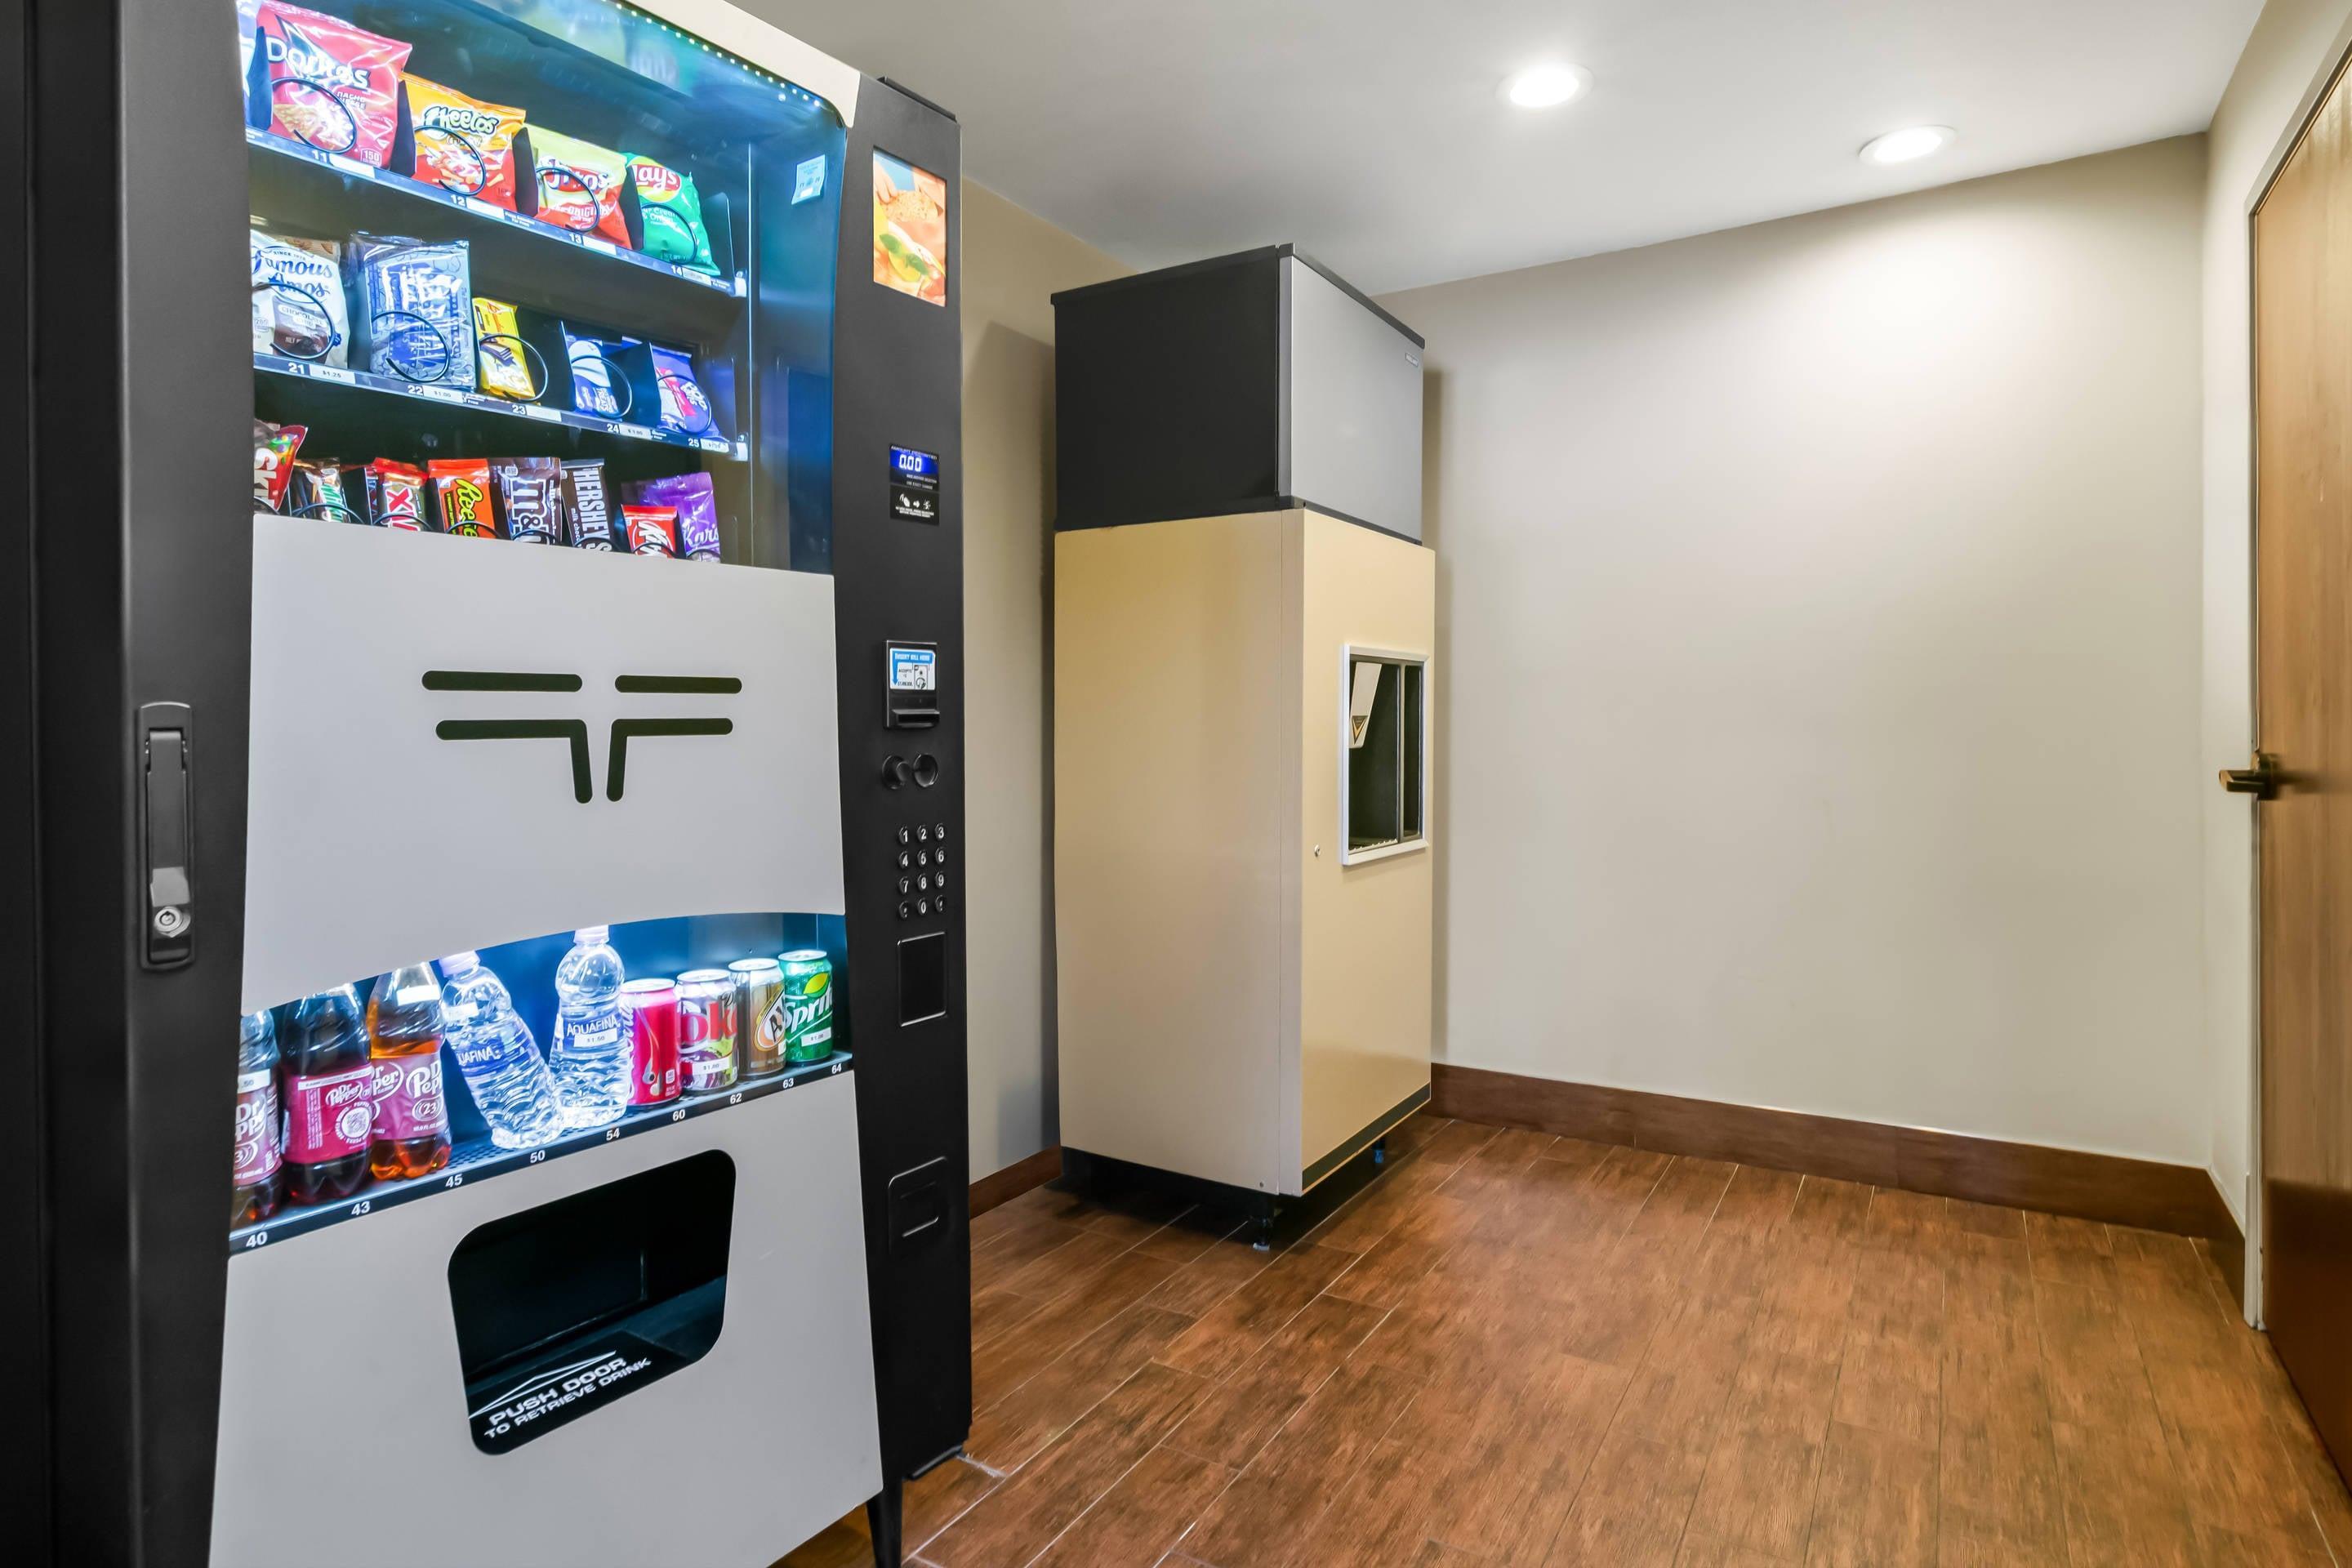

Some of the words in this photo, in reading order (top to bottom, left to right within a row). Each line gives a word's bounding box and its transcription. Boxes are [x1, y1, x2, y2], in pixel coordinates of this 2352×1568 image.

[424, 106, 500, 140] Cheetos
[312, 150, 327, 163] 11
[363, 150, 380, 161] 150
[451, 195, 466, 206] 12
[569, 234, 581, 243] 13
[671, 265, 683, 276] 14
[268, 272, 330, 297] Amos
[288, 362, 305, 374] 21
[408, 385, 423, 395] 22
[512, 404, 525, 414] 23
[607, 424, 619, 433] 24
[688, 438, 699, 448] 25
[455, 479, 483, 537] Reese
[573, 468, 612, 551] HERSHEYS
[903, 830, 907, 842] 1
[921, 828, 926, 840] 2
[938, 826, 944, 839] 3
[902, 854, 908, 866] 4
[938, 850, 944, 862] 6
[903, 880, 908, 893] 7
[921, 877, 926, 889] 8
[938, 875, 944, 886] 9
[921, 902, 926, 913] 0
[458, 1046, 495, 1067] UAFINA
[831, 1063, 842, 1073] 64
[783, 1078, 794, 1089] 63
[730, 1094, 742, 1103] 62
[423, 1102, 436, 1116] 23
[672, 1110, 685, 1121] 60
[606, 1128, 620, 1140] 54
[530, 1150, 546, 1163] 50
[445, 1174, 463, 1188] 45
[351, 1201, 371, 1215] 43
[246, 1232, 268, 1248] 40
[483, 1423, 510, 1438] TO
[514, 1385, 596, 1427] RETRIEVE
[599, 1357, 652, 1388] DRINK
[489, 1388, 559, 1426] PUSH
[562, 1357, 627, 1392] DOOR
